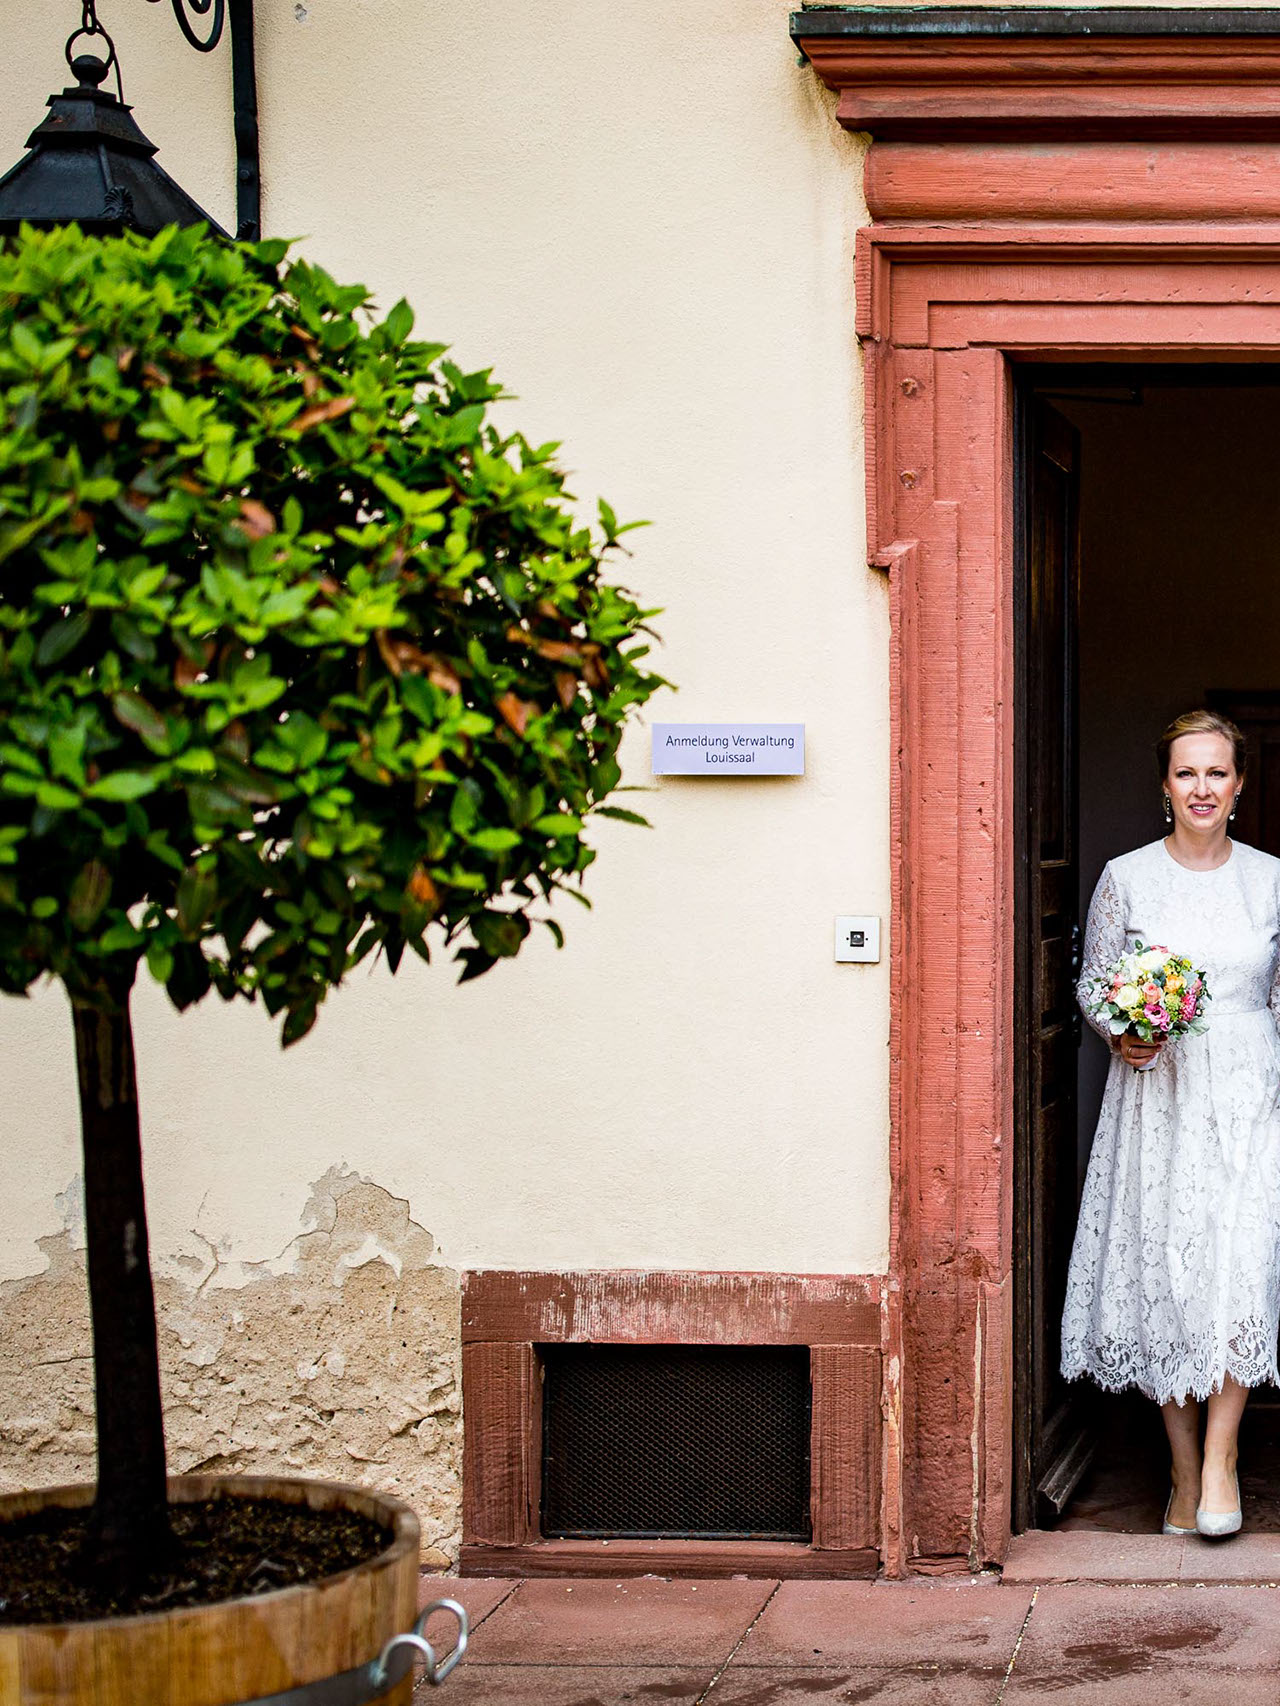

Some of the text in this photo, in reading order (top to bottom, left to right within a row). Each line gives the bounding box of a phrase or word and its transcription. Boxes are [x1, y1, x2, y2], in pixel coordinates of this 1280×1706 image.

[665, 735, 795, 749] Anmeldung Verwaltung
[705, 751, 755, 763] Louissaal
